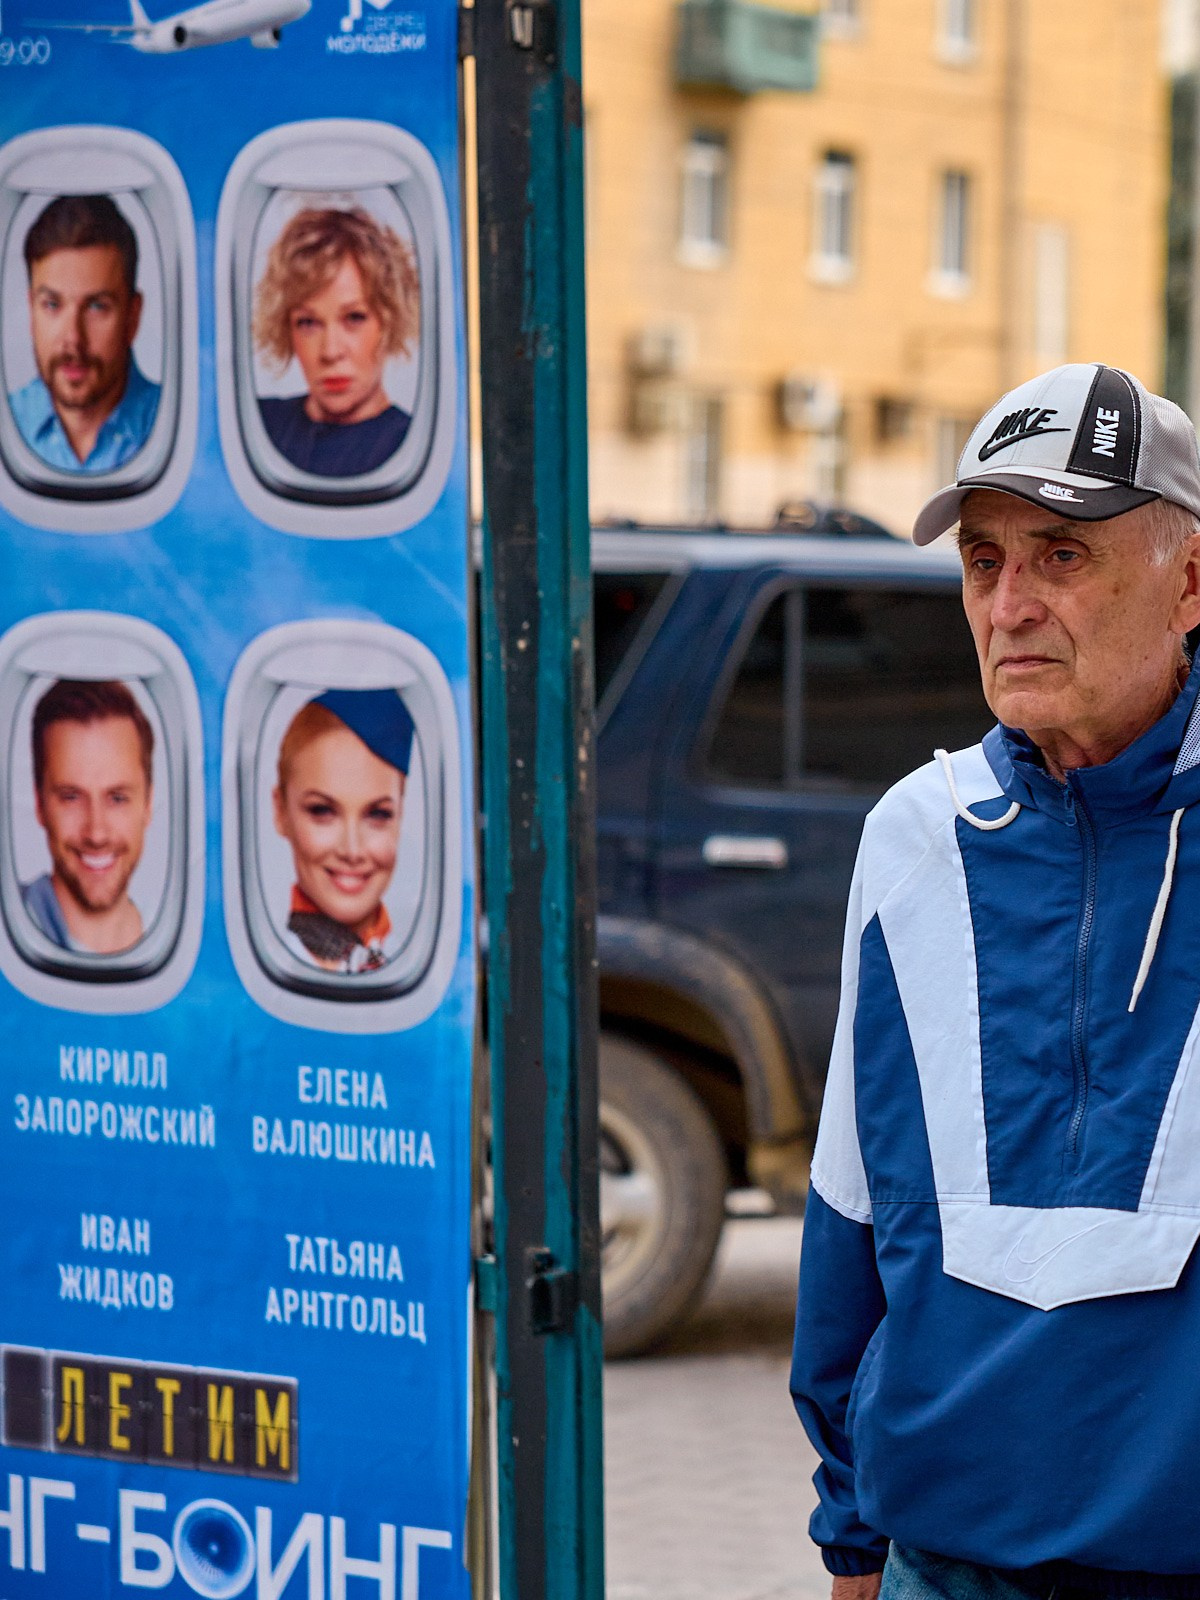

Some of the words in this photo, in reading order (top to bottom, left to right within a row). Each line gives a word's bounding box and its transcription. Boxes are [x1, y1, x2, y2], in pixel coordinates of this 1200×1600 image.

[990, 407, 1058, 441] NIKE
[1092, 406, 1120, 458] NIKE
[1044, 482, 1075, 498] NIKE
[59, 1045, 168, 1090] КИРИЛЛ
[298, 1066, 389, 1110] ЕЛЕНА
[14, 1094, 217, 1148] ЗАПОРОЖСКИЙ
[251, 1115, 436, 1169] ВАЛЮШКИНА
[80, 1213, 151, 1256] ИВАН
[285, 1233, 404, 1282] ТАТЬЯНА
[57, 1264, 174, 1311] ЖИДКОВ
[265, 1287, 427, 1345] АРНТГОЛЬЦ
[56, 1366, 291, 1471] ЛЕТИМ
